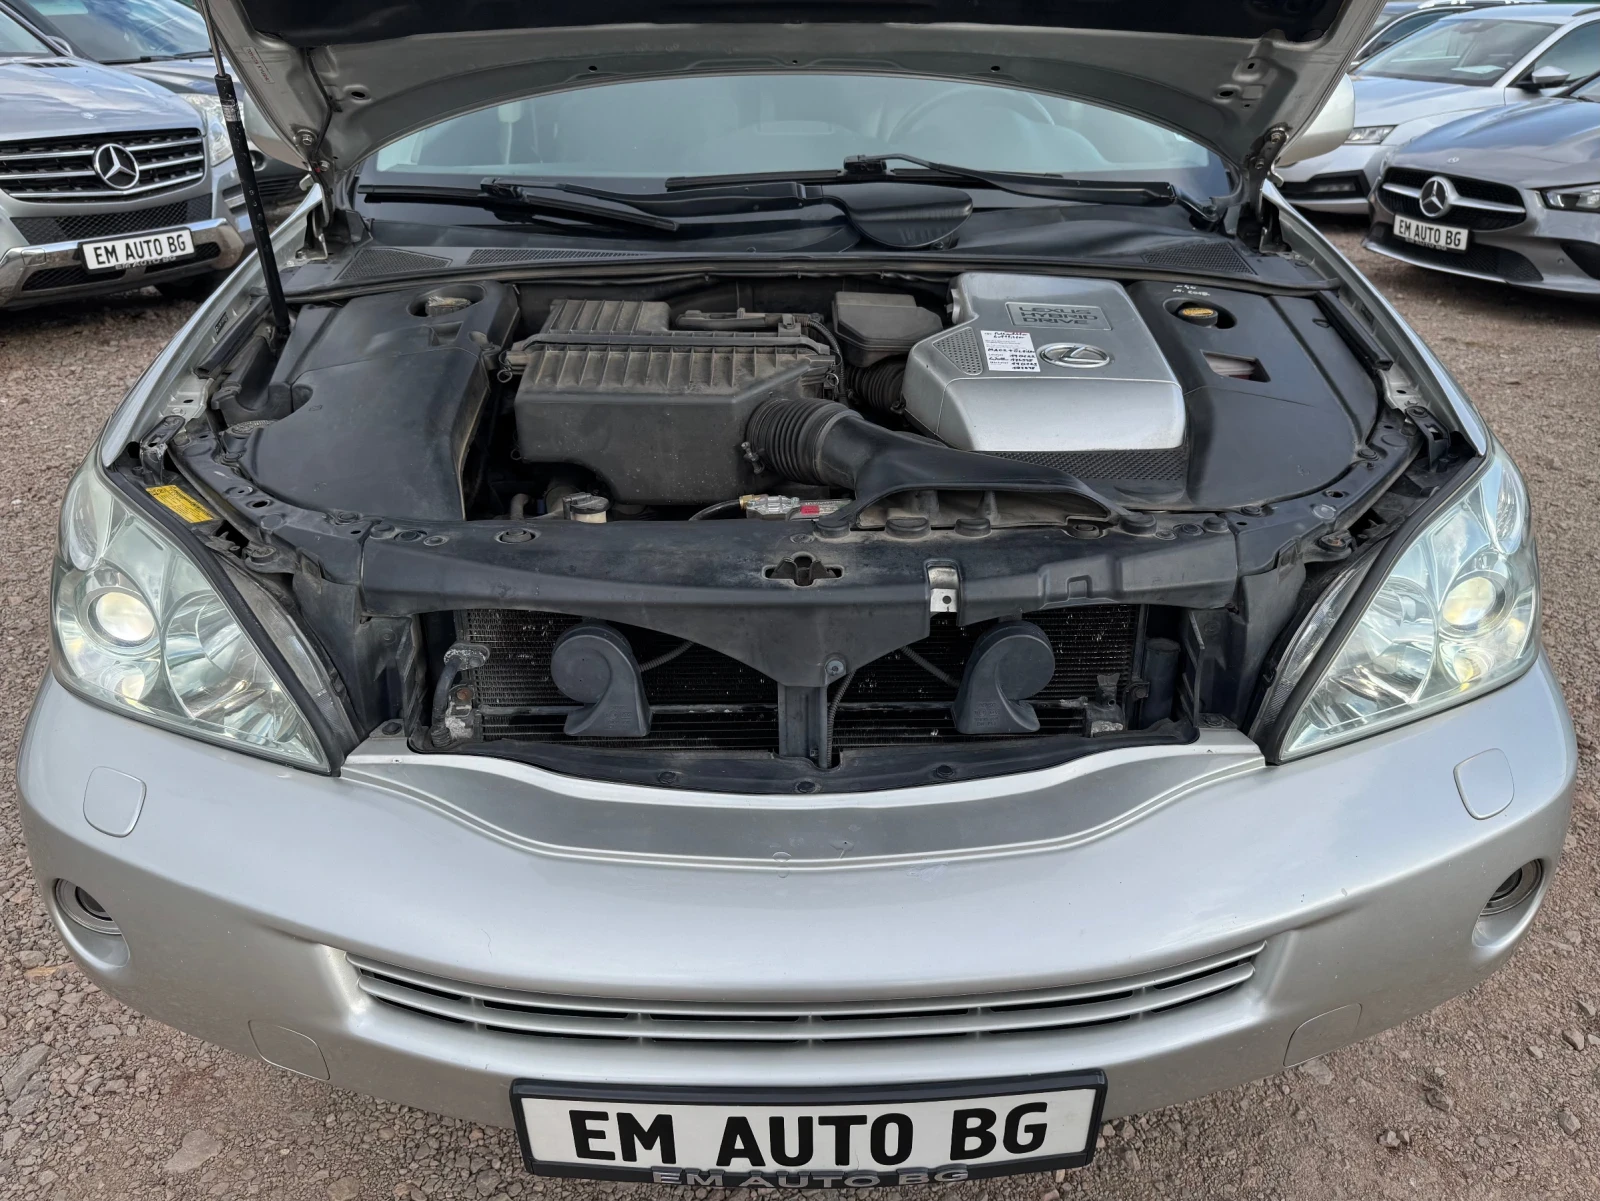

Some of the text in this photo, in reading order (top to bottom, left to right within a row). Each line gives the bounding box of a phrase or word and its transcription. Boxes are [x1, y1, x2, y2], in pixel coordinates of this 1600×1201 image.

[1399, 220, 1461, 246] EM AUTO BG
[94, 234, 186, 265] EM AUTO BG
[132, 258, 160, 268] AUTO
[1019, 306, 1092, 314] LEXUS
[568, 1102, 1048, 1167] EM AUTO BG
[652, 1166, 968, 1188] EM AUTO BG
